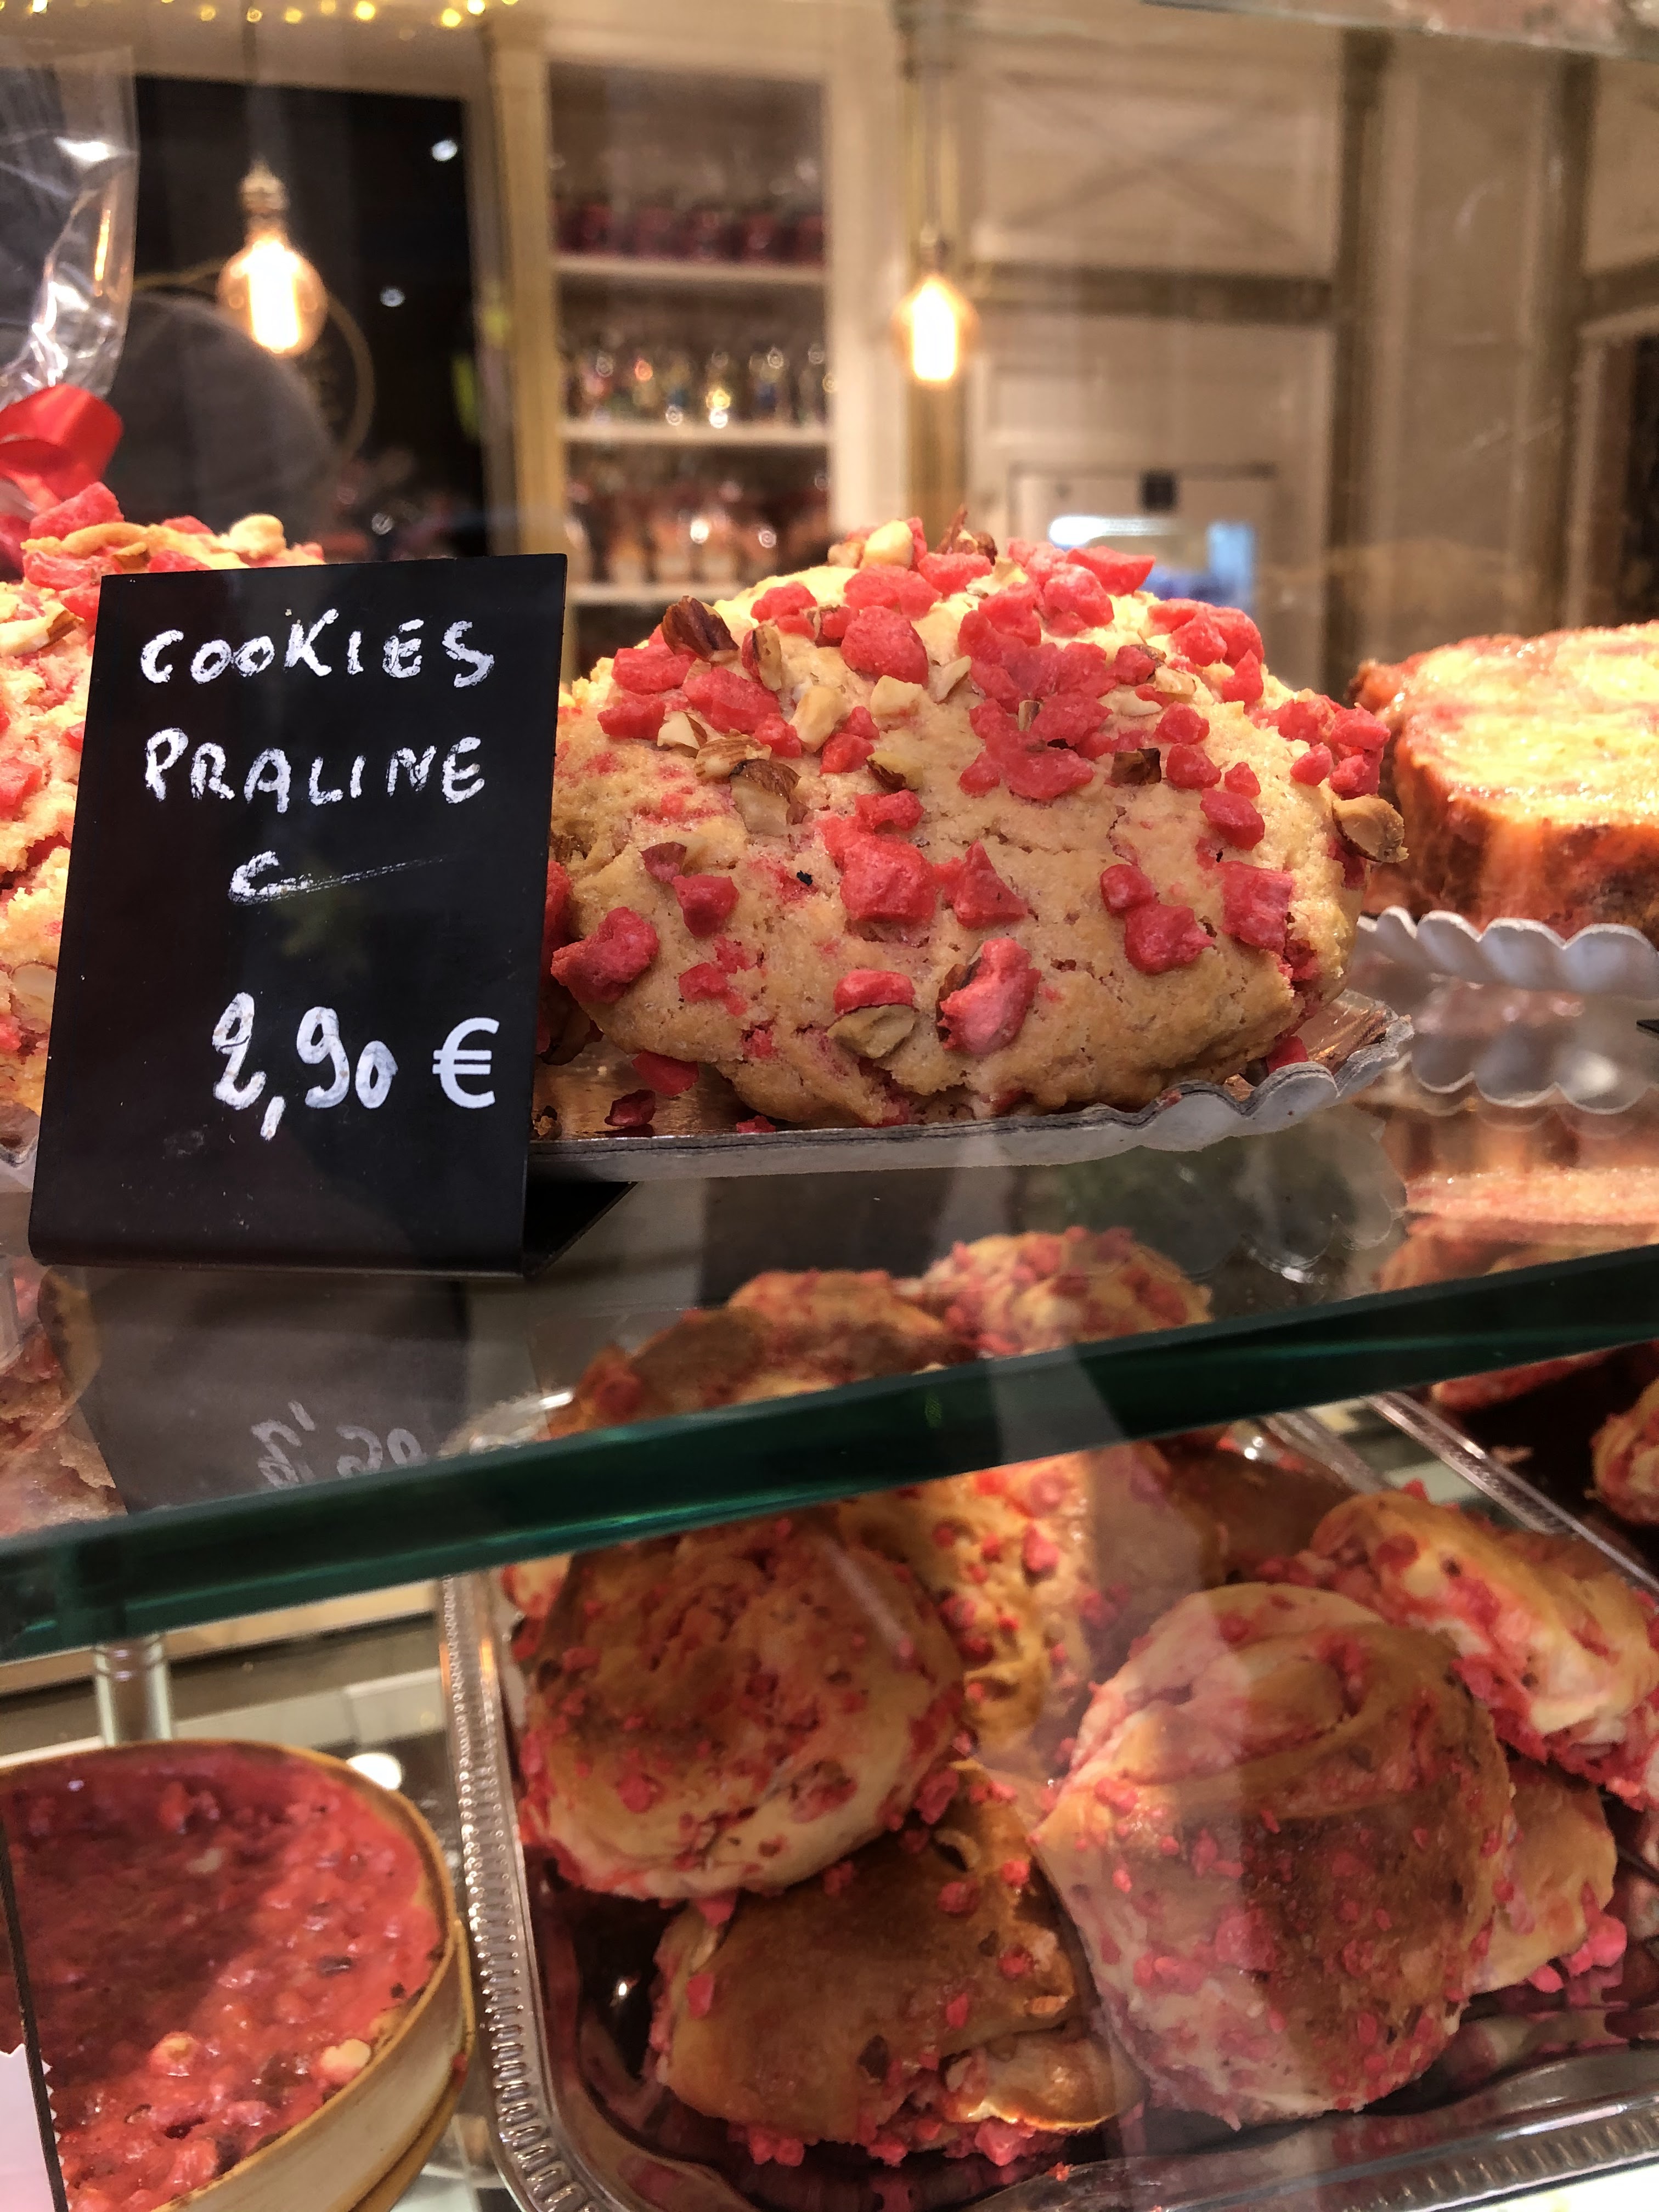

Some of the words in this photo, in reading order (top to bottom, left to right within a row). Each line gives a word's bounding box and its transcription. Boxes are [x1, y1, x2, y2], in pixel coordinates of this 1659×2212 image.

[140, 607, 495, 688] COOKIES
[144, 727, 485, 814] PRALINE
[212, 992, 398, 1141] 2,90
[432, 1017, 500, 1109] €
